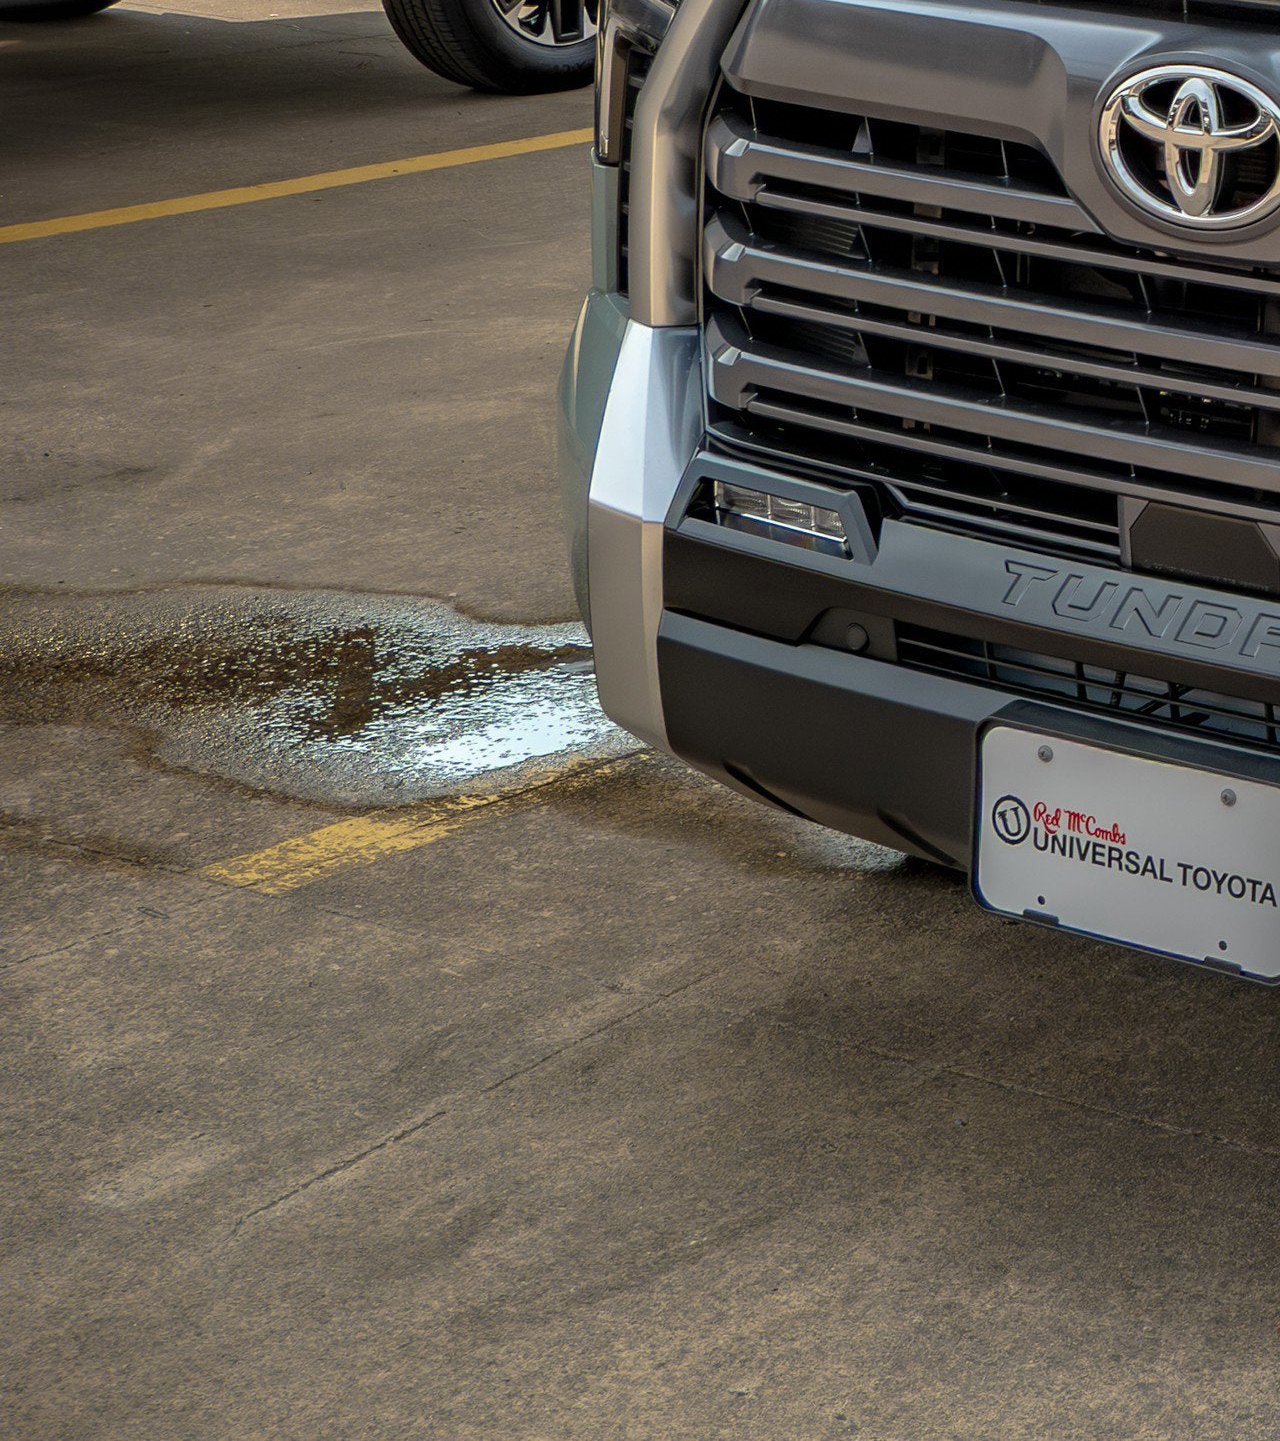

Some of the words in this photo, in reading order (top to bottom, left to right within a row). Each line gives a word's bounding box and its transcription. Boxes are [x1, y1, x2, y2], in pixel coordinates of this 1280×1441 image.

[1033, 801, 1060, 834] Red
[1064, 810, 1127, 845] McCombs
[1033, 827, 1173, 883] UNIVERSAL
[1177, 862, 1278, 907] TOYOTA
